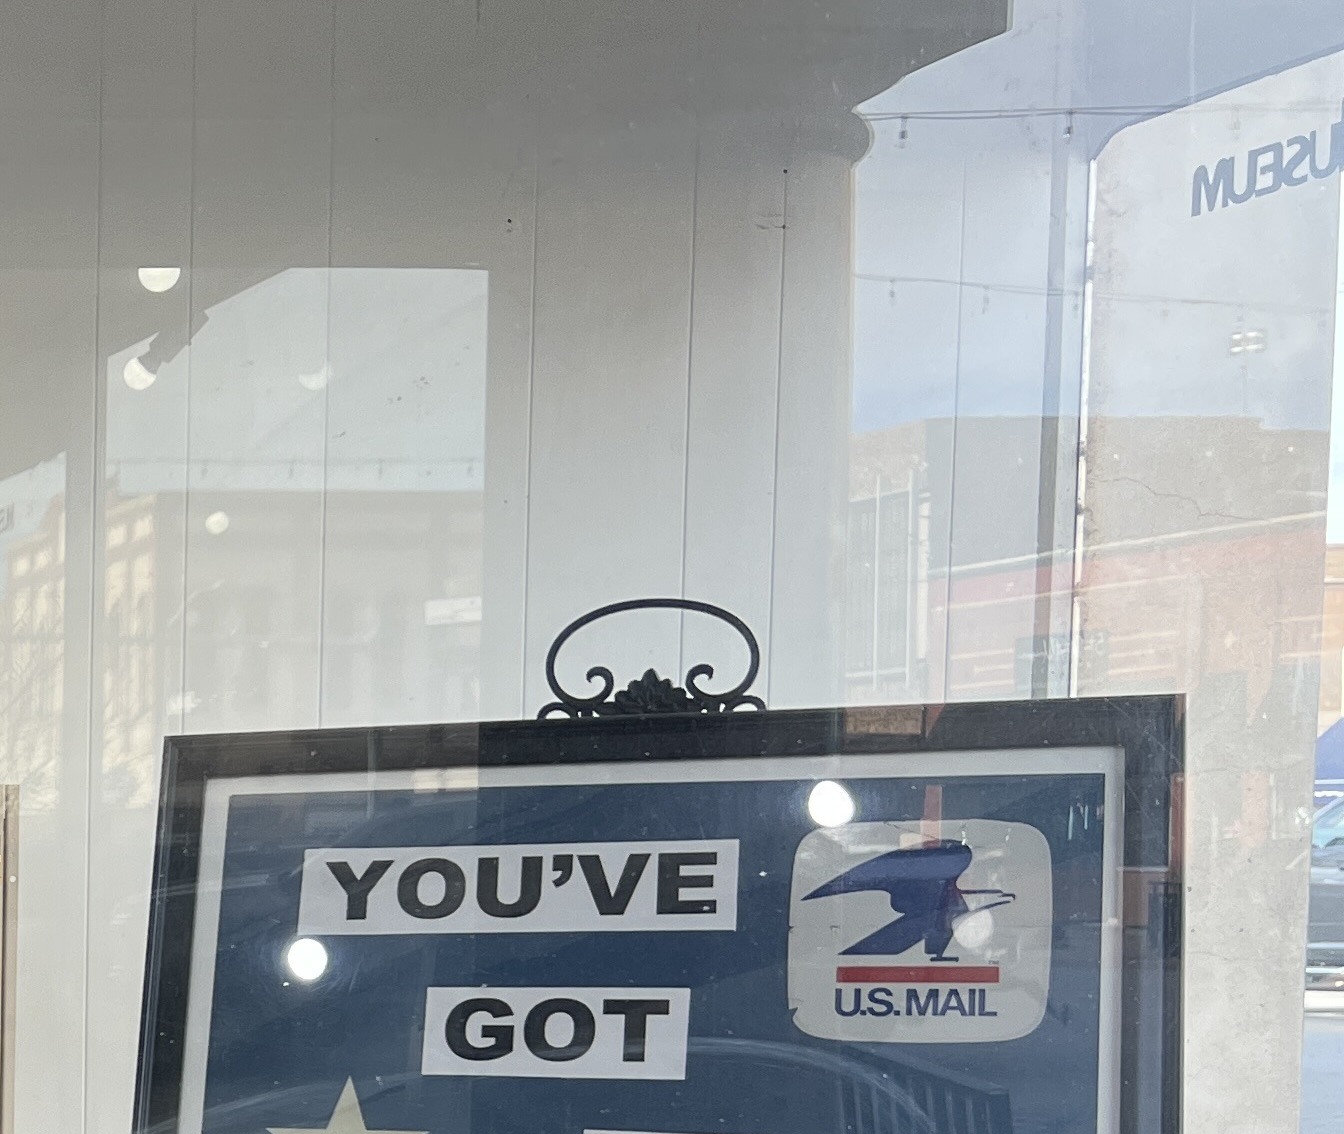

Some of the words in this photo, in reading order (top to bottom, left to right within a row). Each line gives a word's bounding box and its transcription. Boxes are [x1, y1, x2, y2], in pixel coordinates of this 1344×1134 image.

[326, 851, 718, 921] YOU'VE
[445, 997, 670, 1062] GOT
[834, 987, 901, 1017] U.S.
[906, 988, 998, 1017] MAIL
